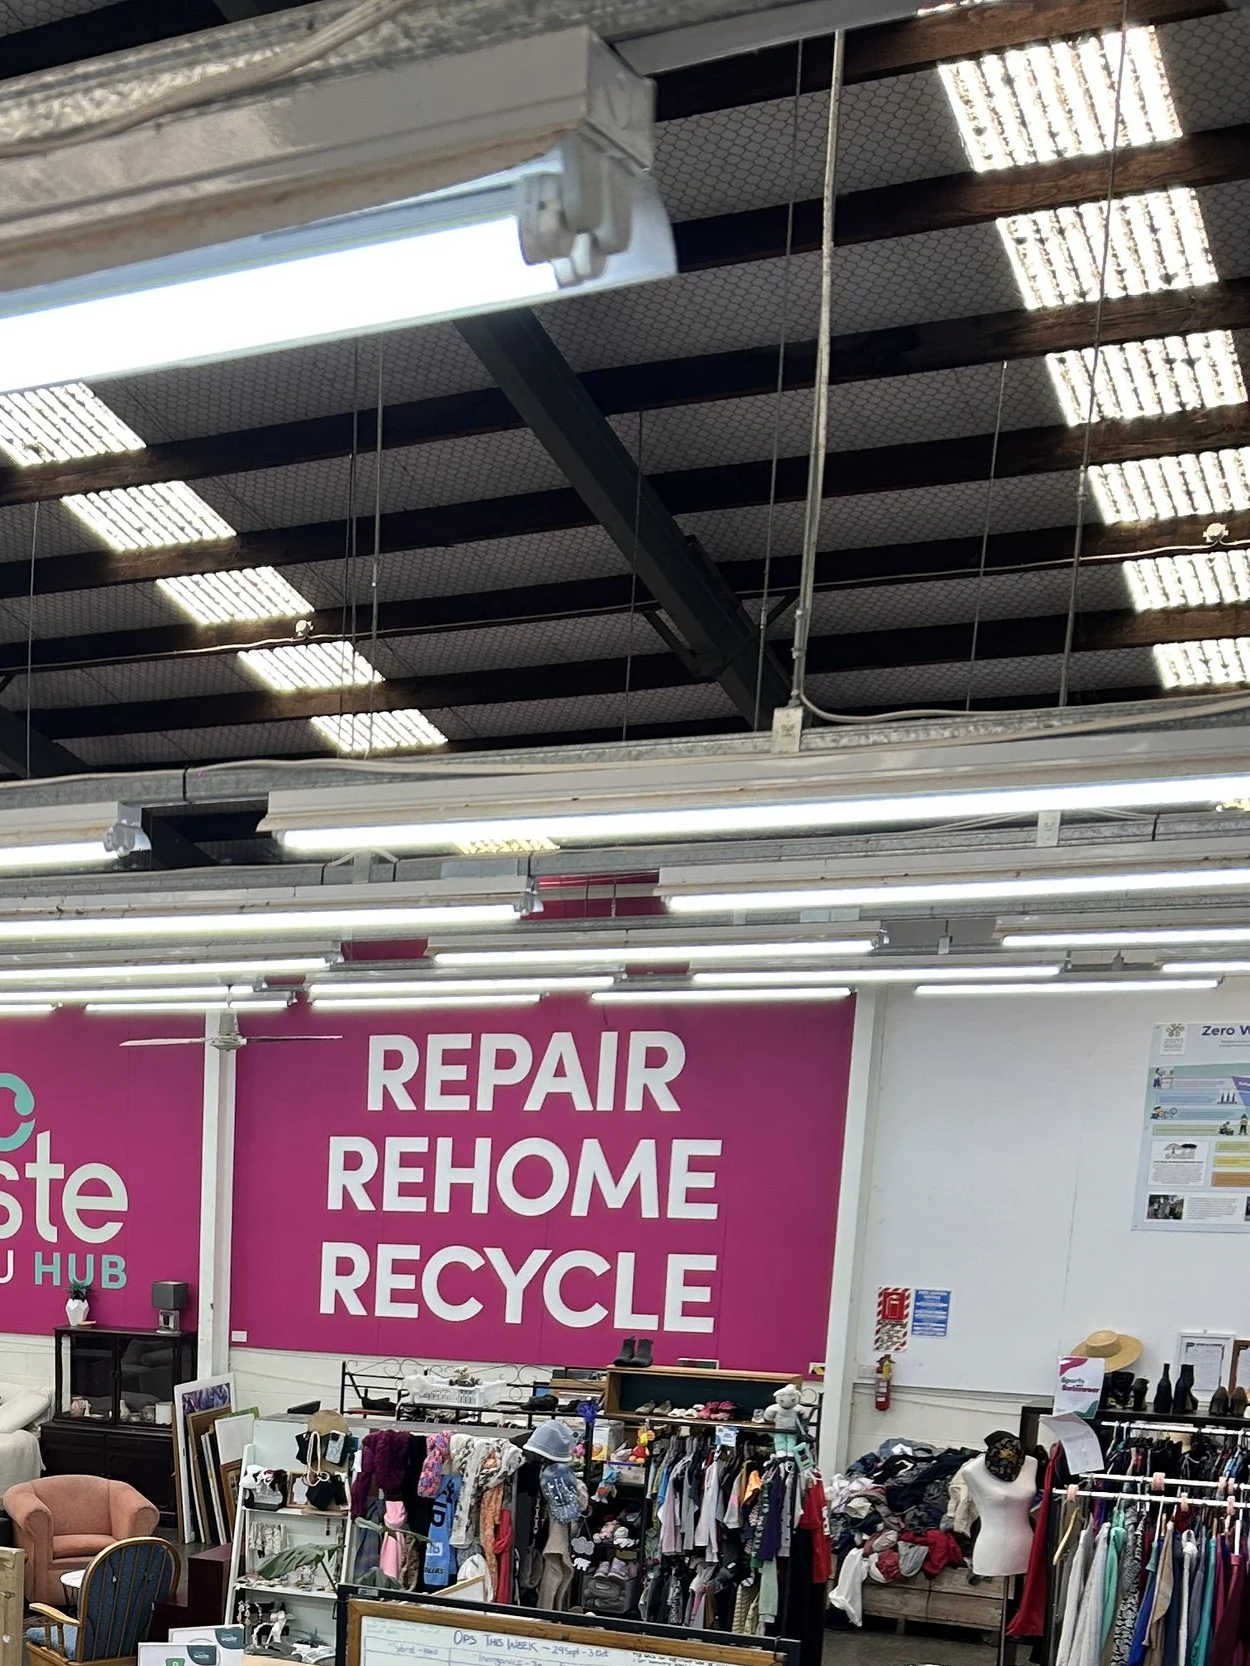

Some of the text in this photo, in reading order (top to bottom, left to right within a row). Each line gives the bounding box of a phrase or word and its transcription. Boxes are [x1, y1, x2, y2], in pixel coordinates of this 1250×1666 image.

[1202, 1025, 1235, 1036] Zero
[367, 1030, 686, 1112] REPAIR
[327, 1136, 723, 1220] REHOME
[34, 1252, 128, 1290] HUB
[319, 1241, 718, 1333] RECYCLE
[1061, 1377, 1085, 1385] Sports
[483, 1634, 504, 1647] THIS
[507, 1639, 539, 1652] WEEK
